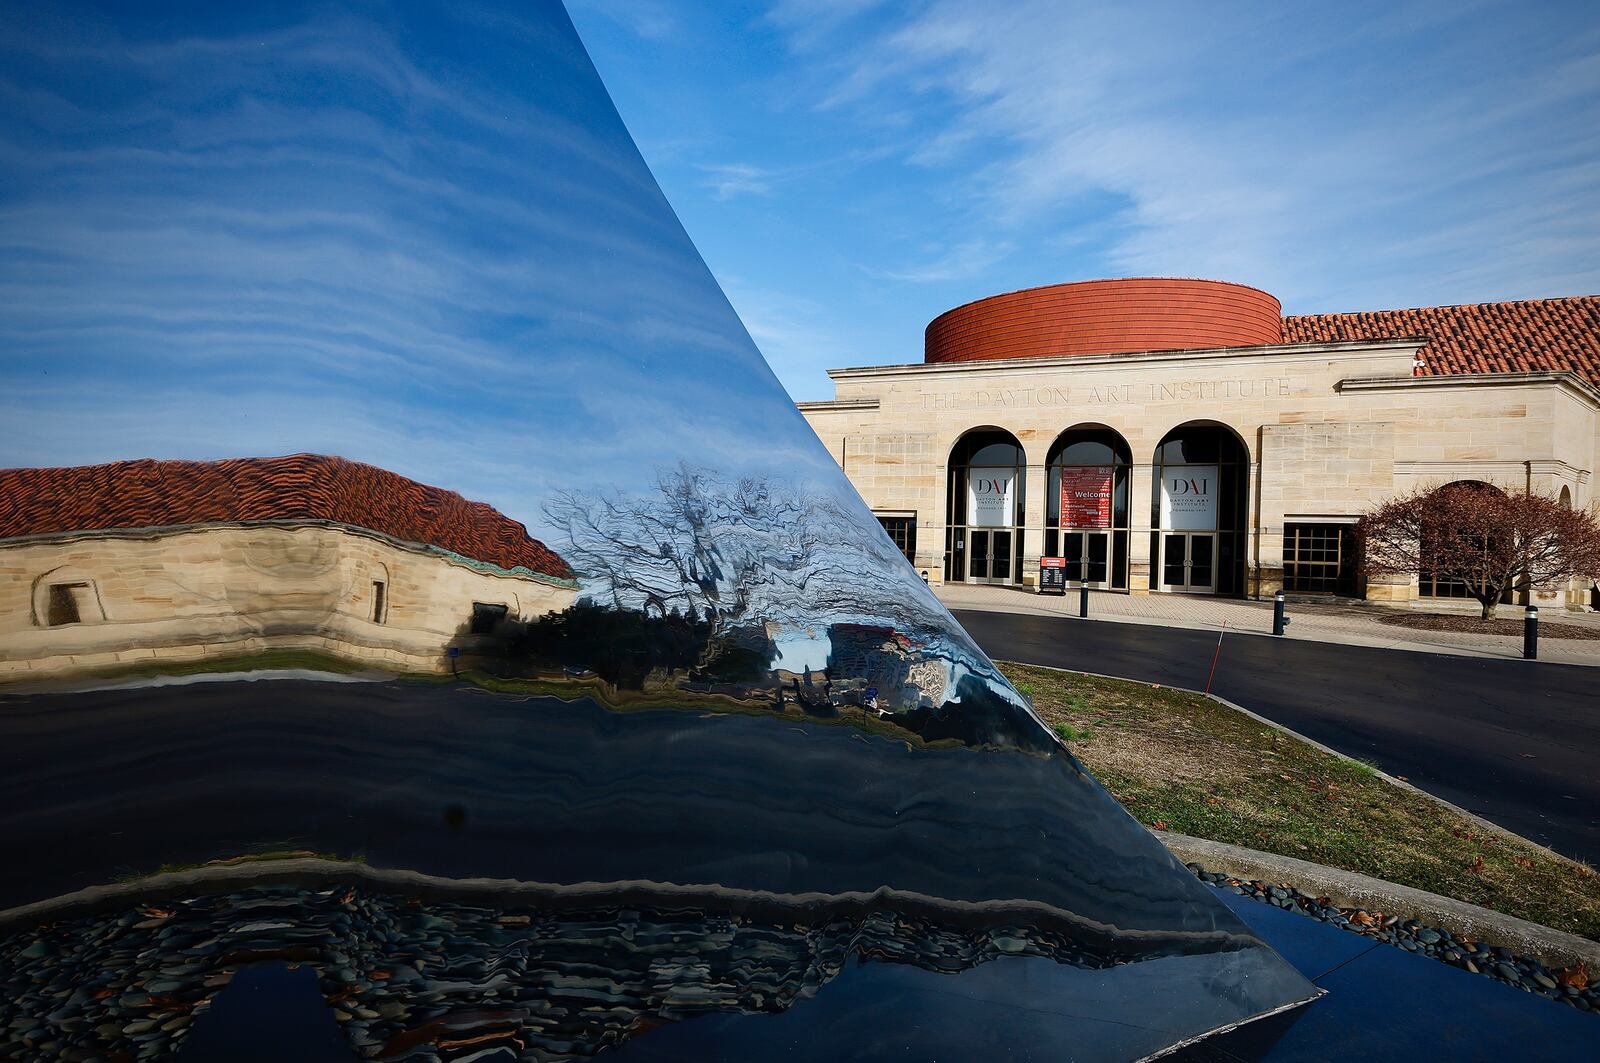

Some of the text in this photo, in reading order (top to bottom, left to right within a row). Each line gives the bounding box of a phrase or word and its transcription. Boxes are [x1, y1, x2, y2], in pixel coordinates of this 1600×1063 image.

[920, 378, 1291, 409] THE DAYTON ART INSTITUTE
[977, 478, 1008, 495] DAI
[1171, 478, 1208, 496] DAI
